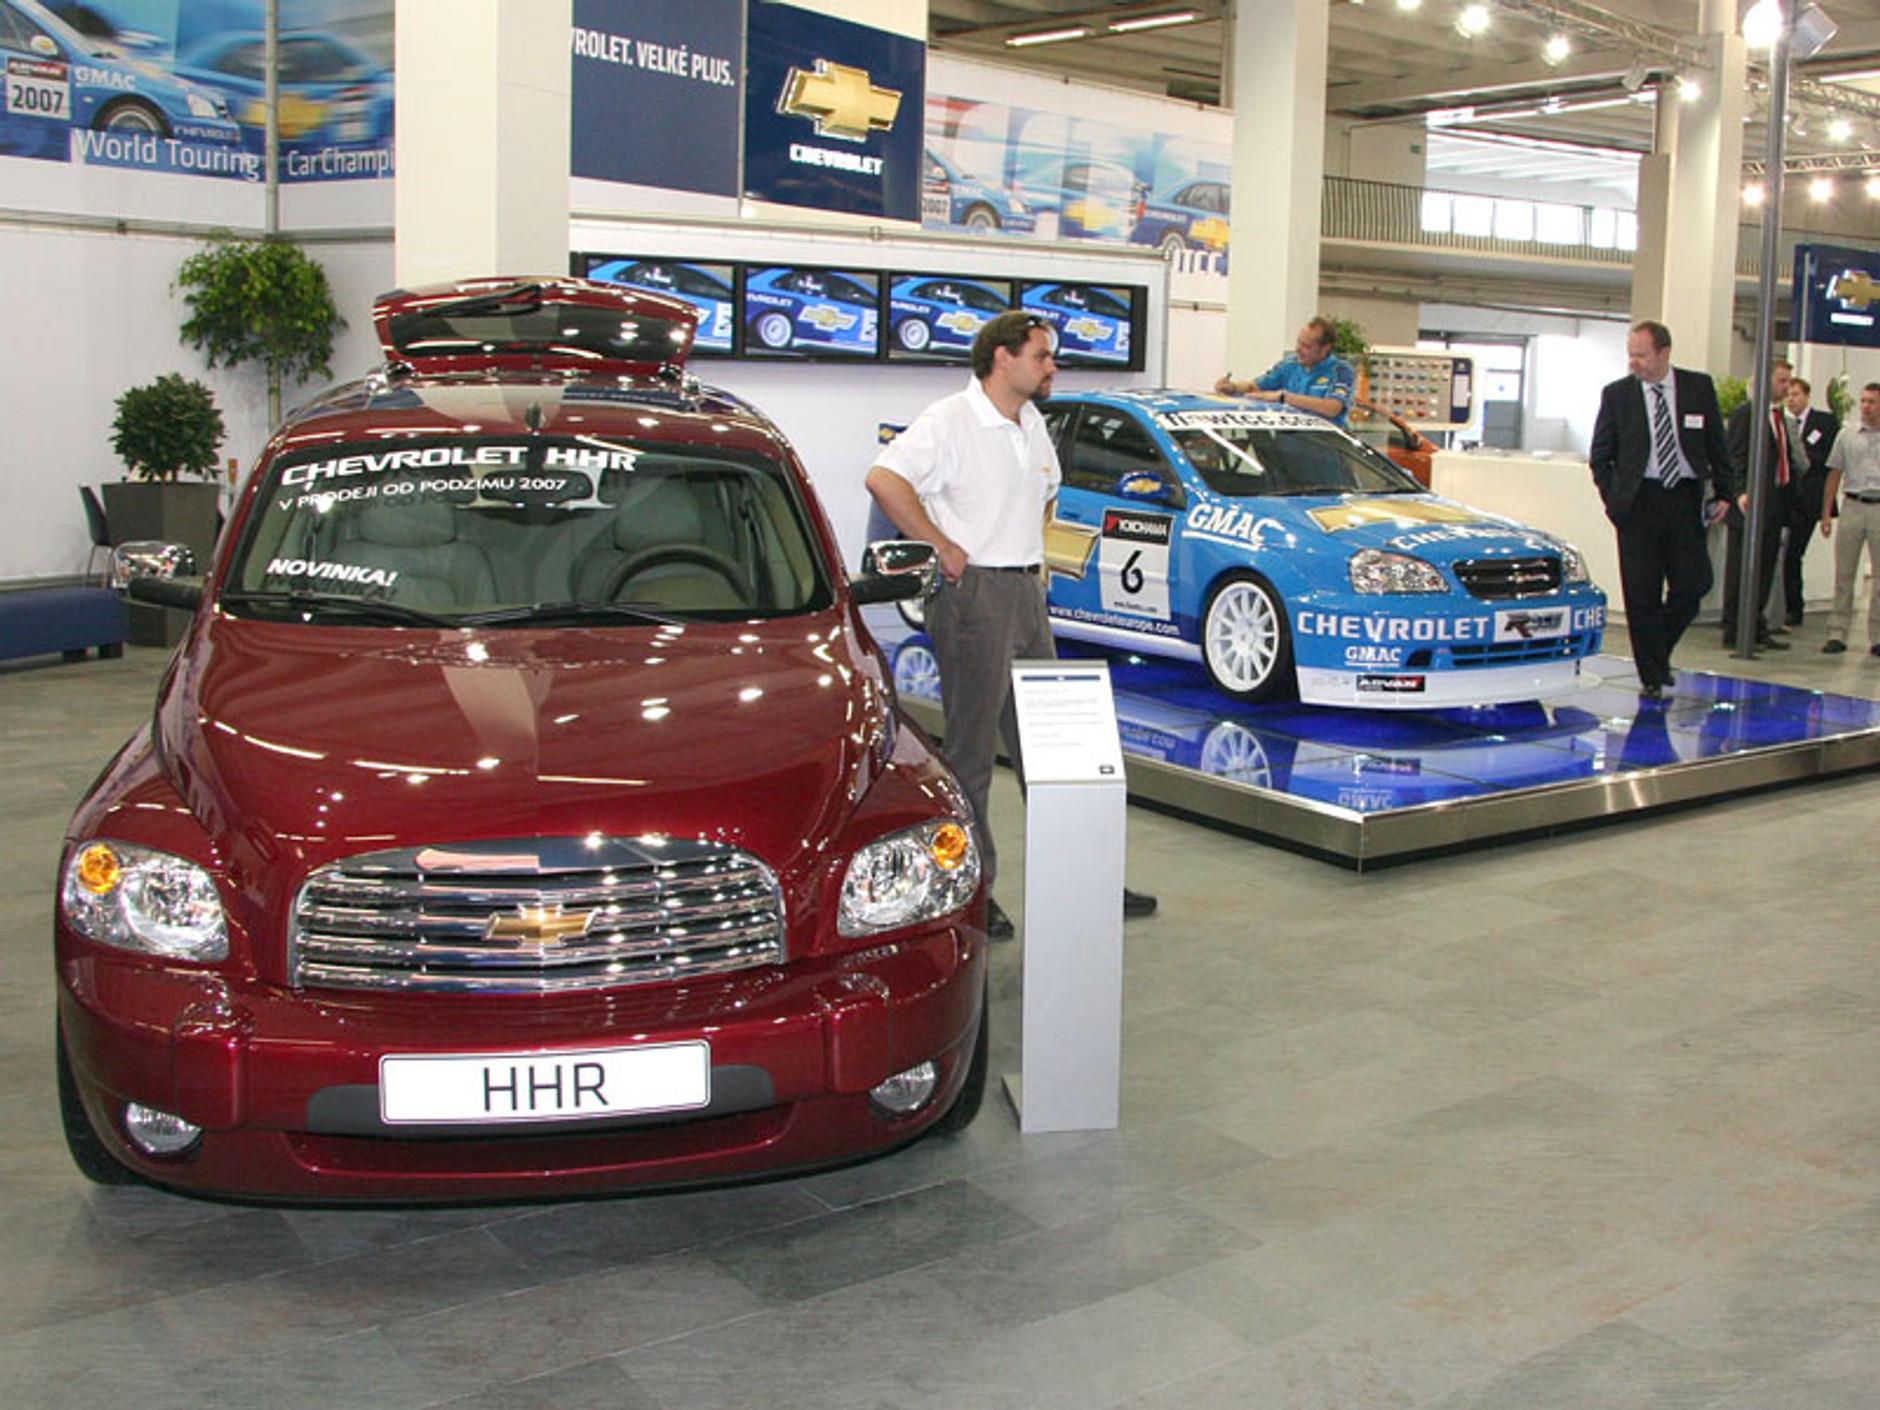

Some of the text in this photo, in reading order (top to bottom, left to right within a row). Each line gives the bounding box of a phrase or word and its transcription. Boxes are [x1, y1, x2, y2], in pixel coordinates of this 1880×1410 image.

[571, 27, 735, 86] ROLET. VELKÉ PLUS.
[75, 66, 135, 90] GMAC
[12, 85, 64, 113] 2007
[79, 129, 156, 164] World
[164, 138, 260, 181] Touring
[789, 143, 884, 175] CHEVROLET
[281, 447, 637, 487] CHEVROLET HHR
[277, 498, 293, 511] V
[382, 483, 414, 496] OD
[420, 477, 514, 492] PODZIMU
[519, 477, 568, 490] 2007
[1186, 503, 1284, 543] GMAC
[266, 558, 398, 588] NOVINKA!
[1120, 550, 1145, 595] 6
[1297, 612, 1490, 642] CHEVROLET
[1345, 646, 1401, 662] GMAC
[483, 1061, 609, 1112] HHR
